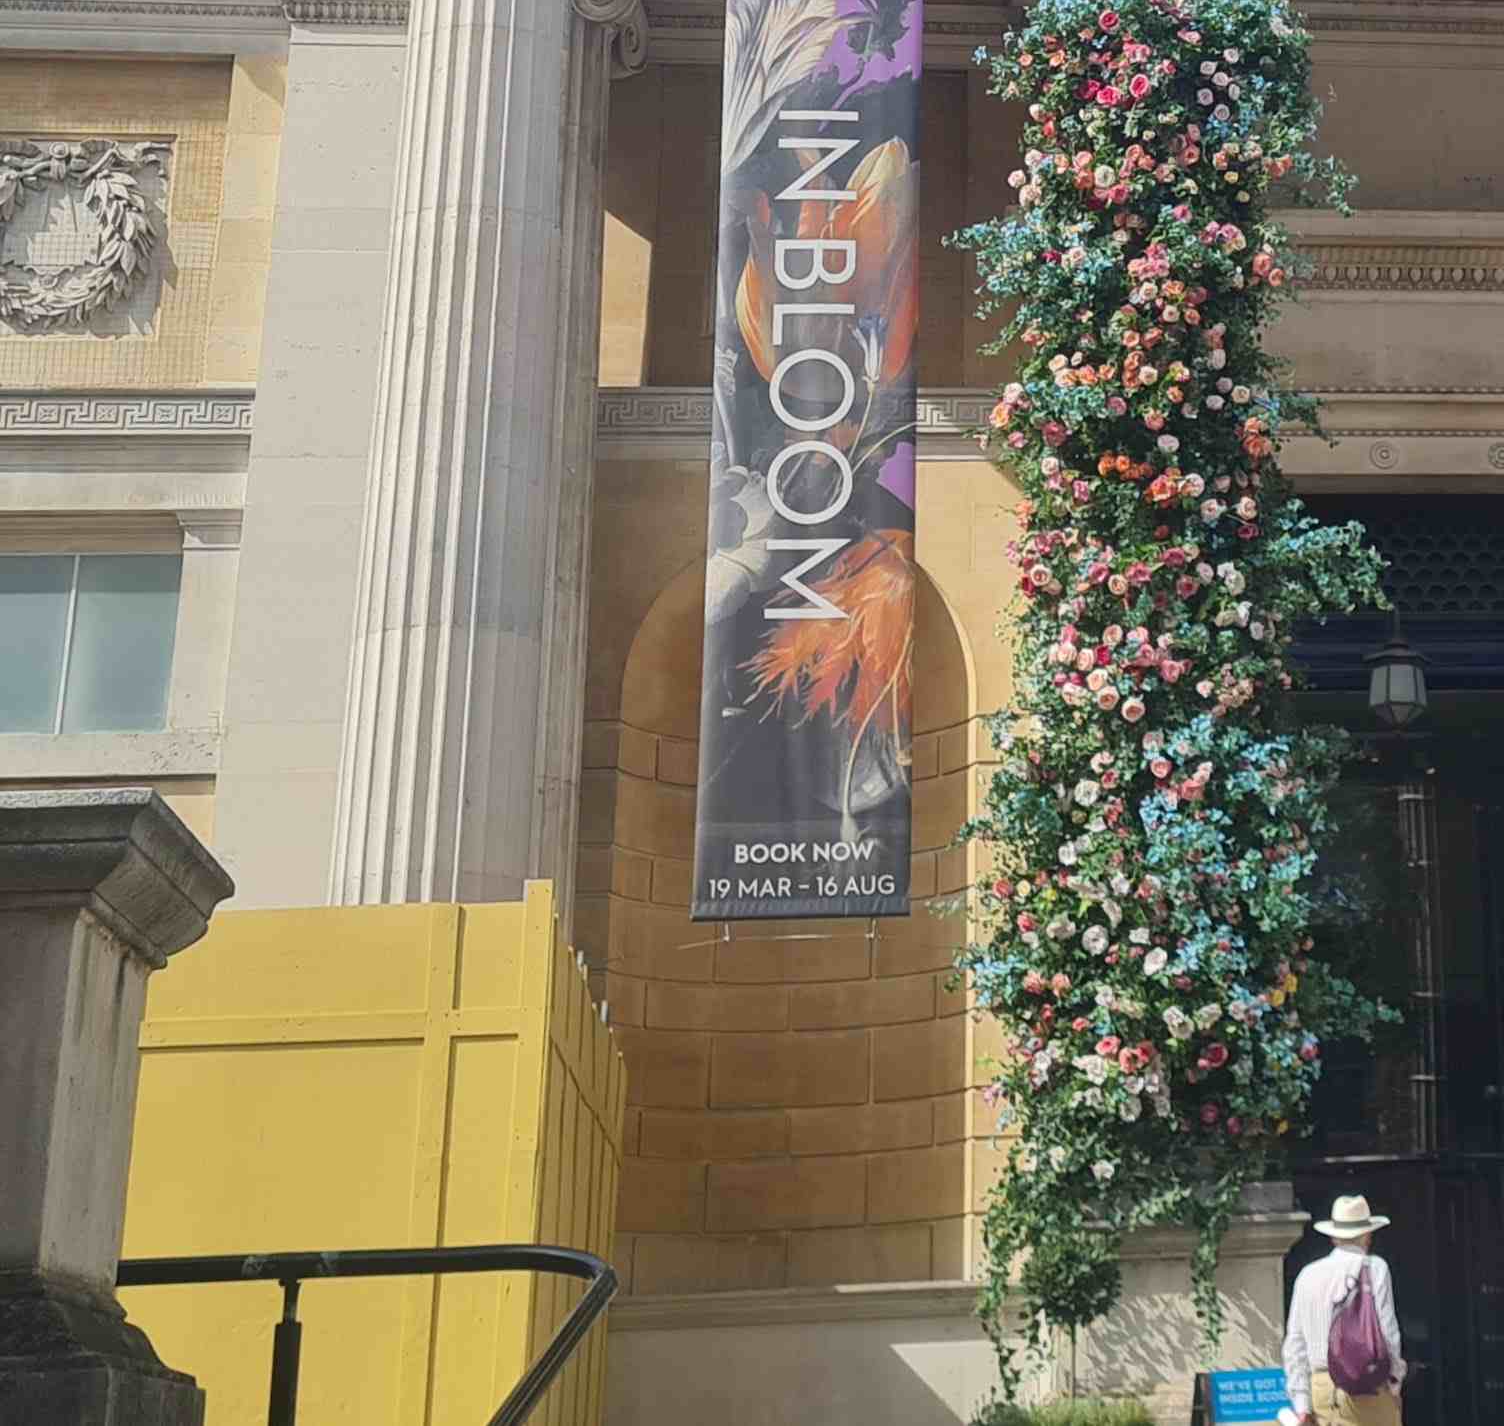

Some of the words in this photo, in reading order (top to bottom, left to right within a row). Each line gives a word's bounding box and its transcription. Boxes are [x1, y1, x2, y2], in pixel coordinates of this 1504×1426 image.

[774, 110, 860, 200] IN
[763, 238, 856, 619] BLOOM
[734, 843, 806, 864] BOOK
[813, 841, 874, 862] NOW
[709, 878, 730, 899] 19
[738, 877, 792, 899] MAR
[816, 876, 838, 895] 16
[844, 874, 895, 895] AUG
